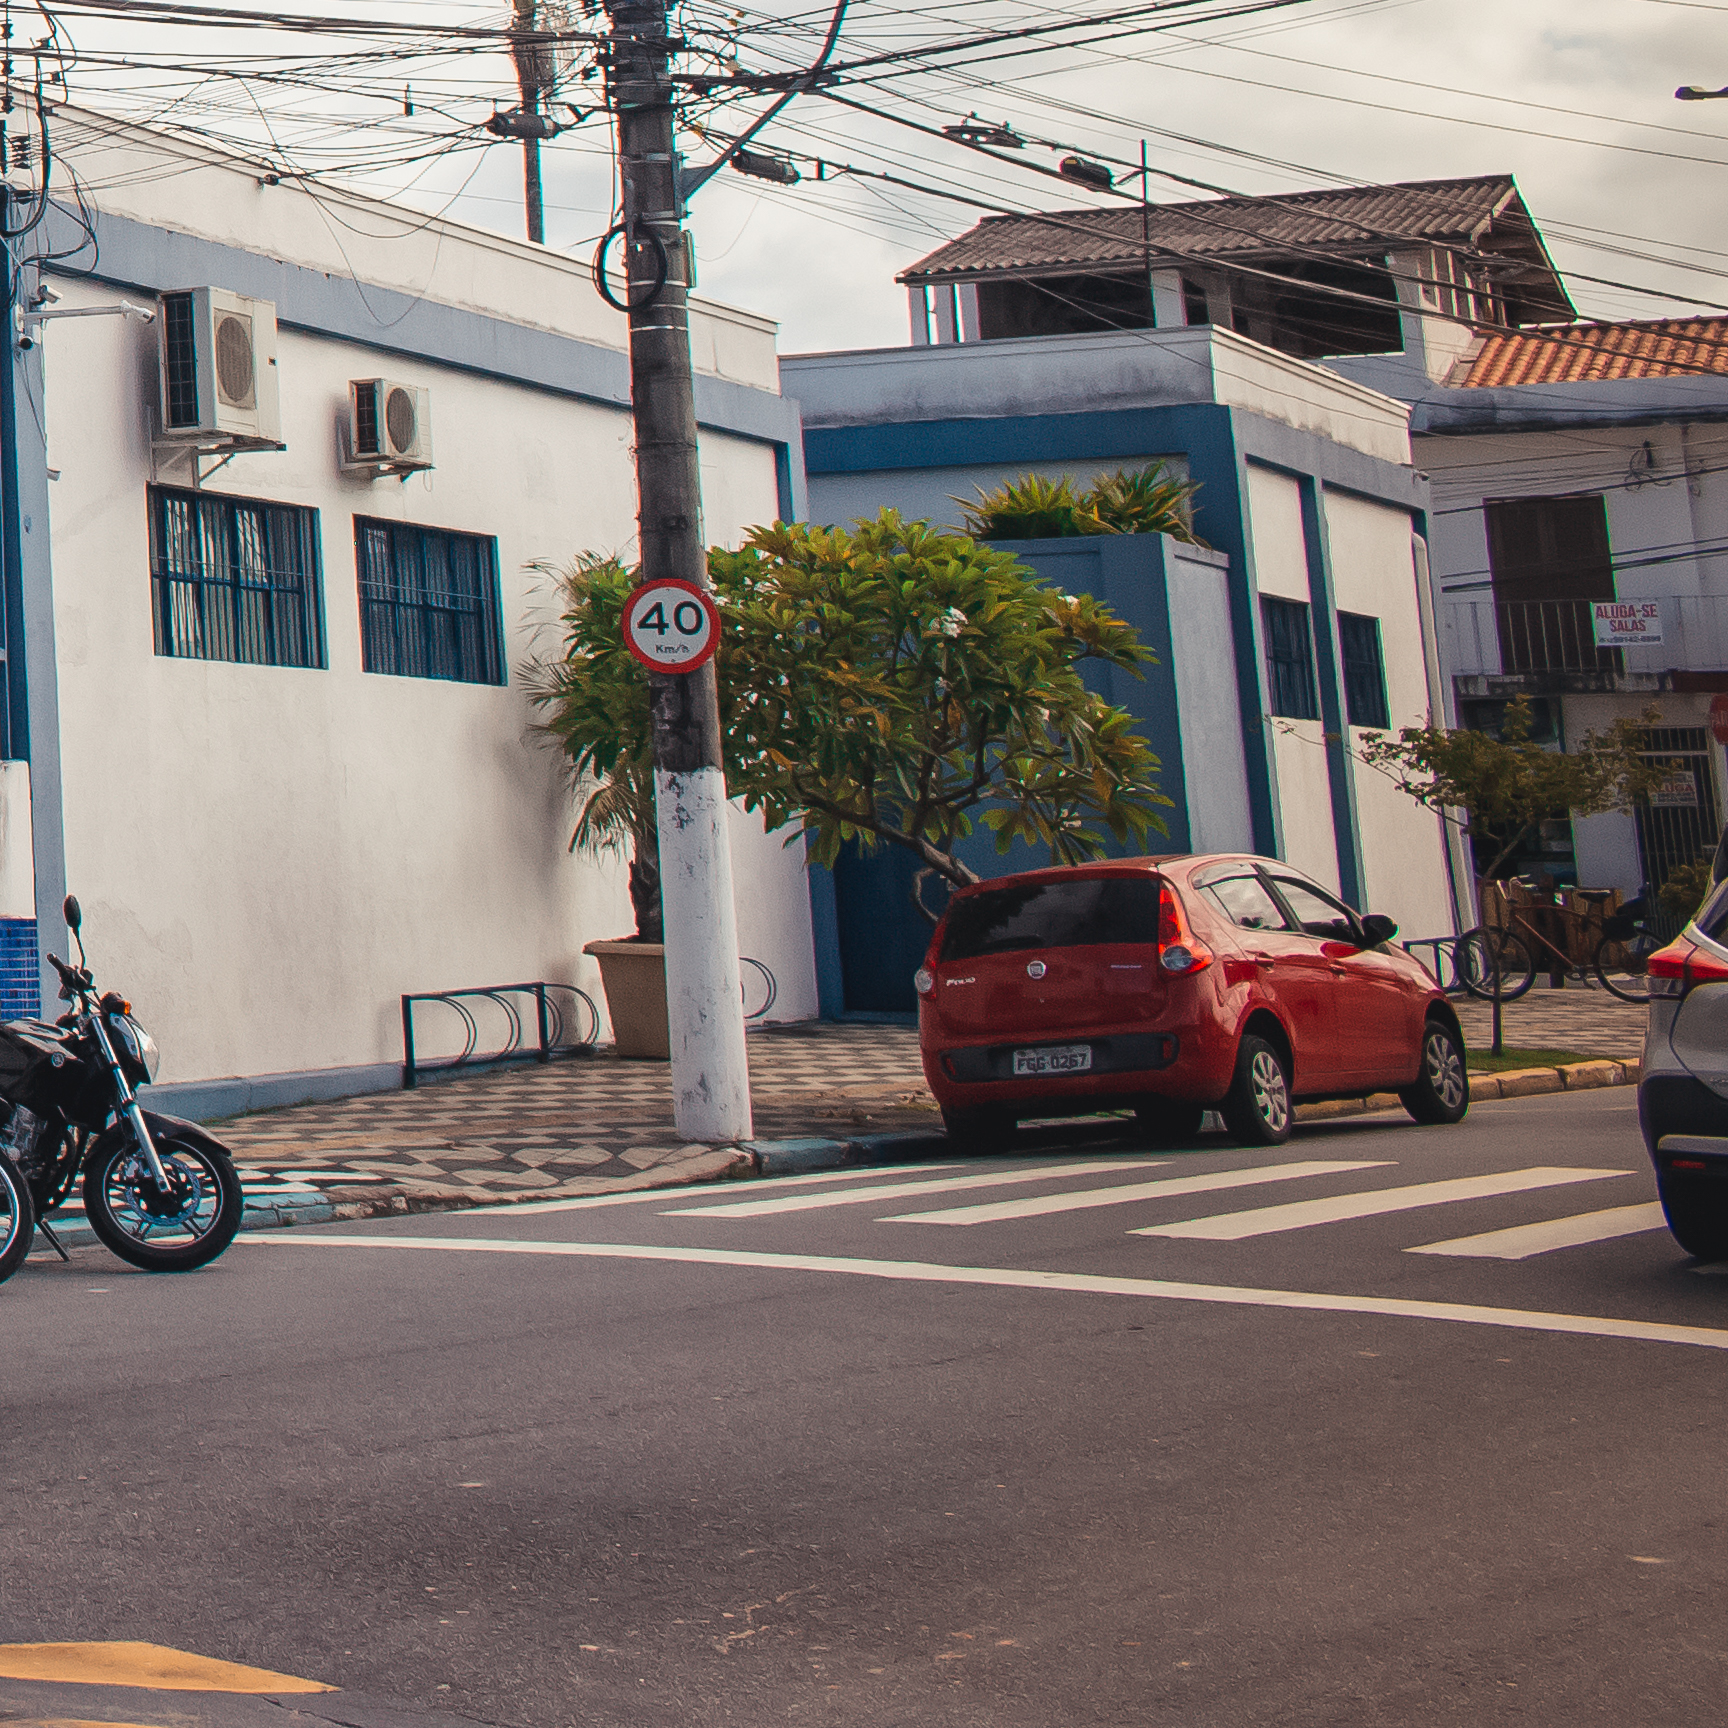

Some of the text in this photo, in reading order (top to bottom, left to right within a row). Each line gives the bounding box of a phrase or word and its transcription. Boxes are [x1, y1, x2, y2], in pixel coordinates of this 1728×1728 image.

[637, 600, 703, 635] 40
[1596, 603, 1659, 619] ALUGA-SE
[1609, 619, 1647, 633] SALAS
